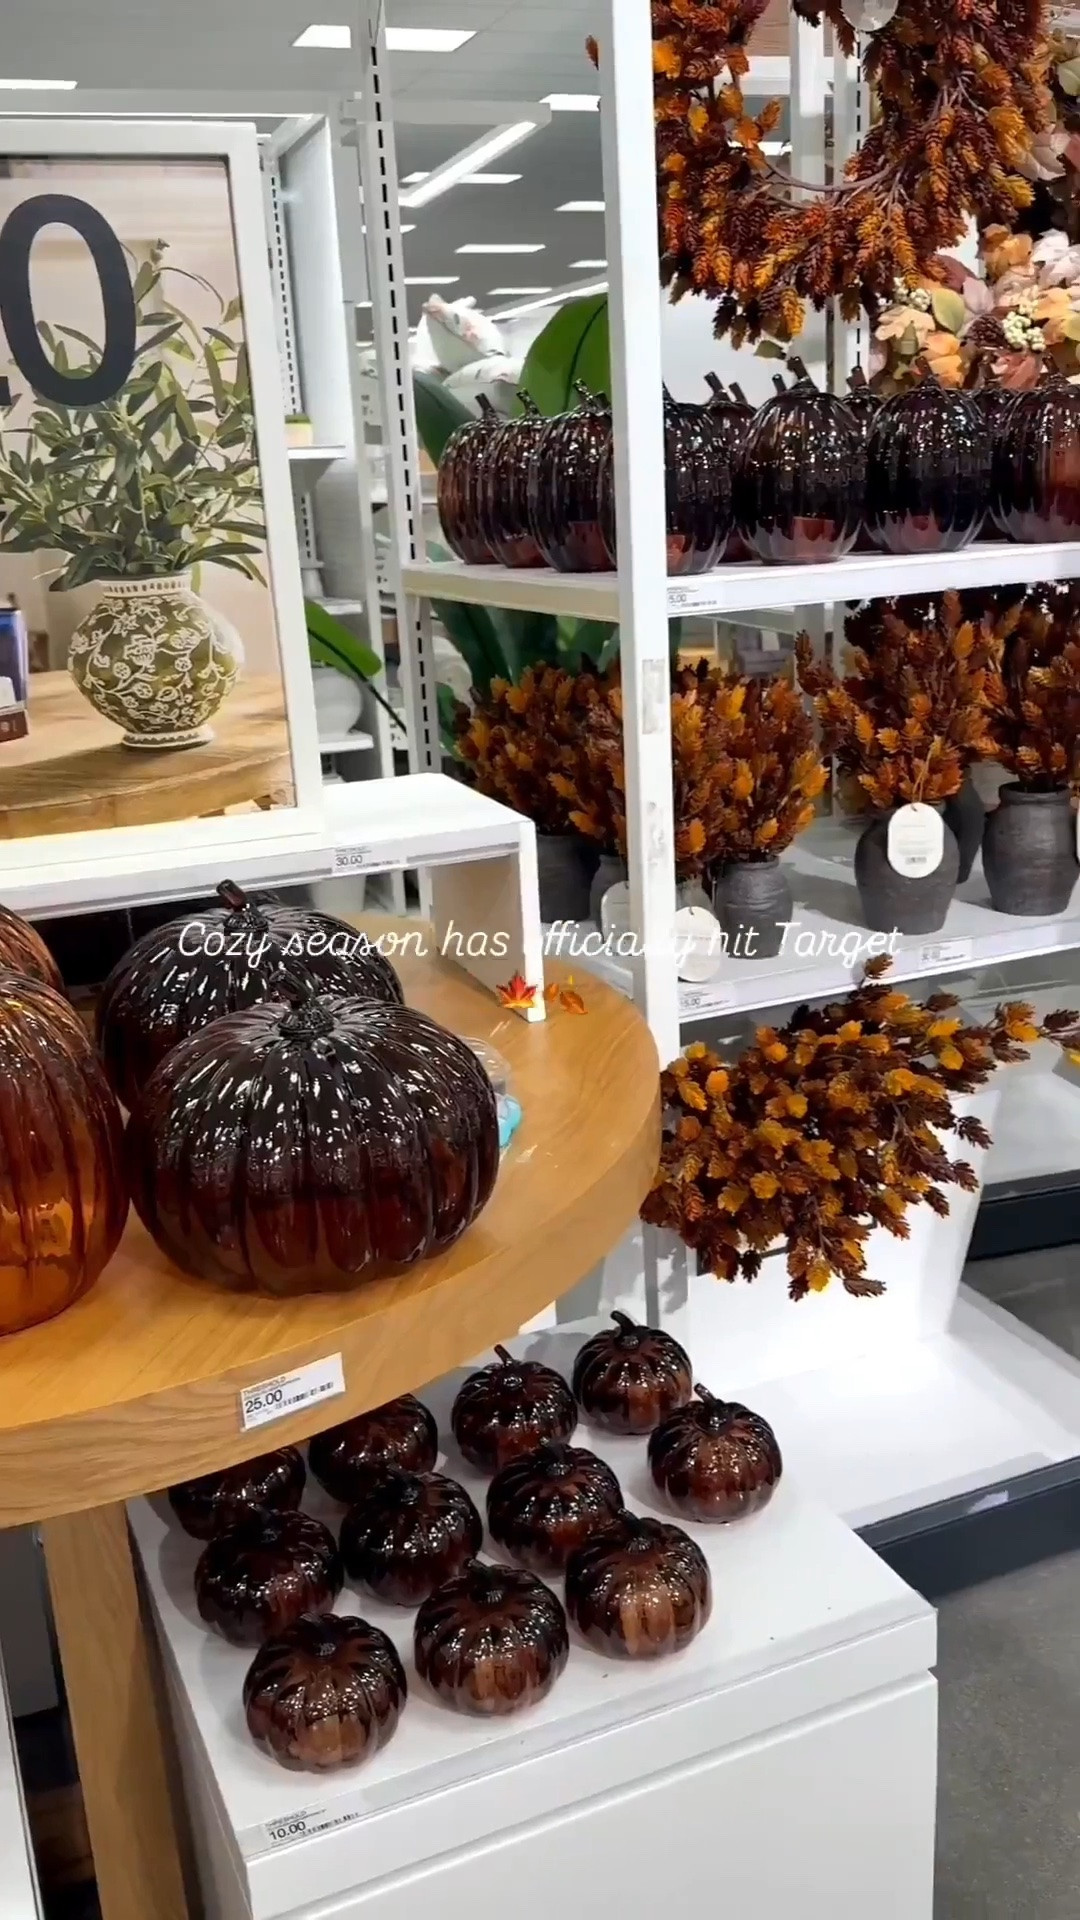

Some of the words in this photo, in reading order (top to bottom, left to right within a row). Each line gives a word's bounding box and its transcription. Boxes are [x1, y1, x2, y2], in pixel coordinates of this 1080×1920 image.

[0, 193, 136, 406] 0
[335, 855, 363, 867] 30.00
[245, 1389, 283, 1414] 25.00
[269, 1820, 307, 1841] 10.00
